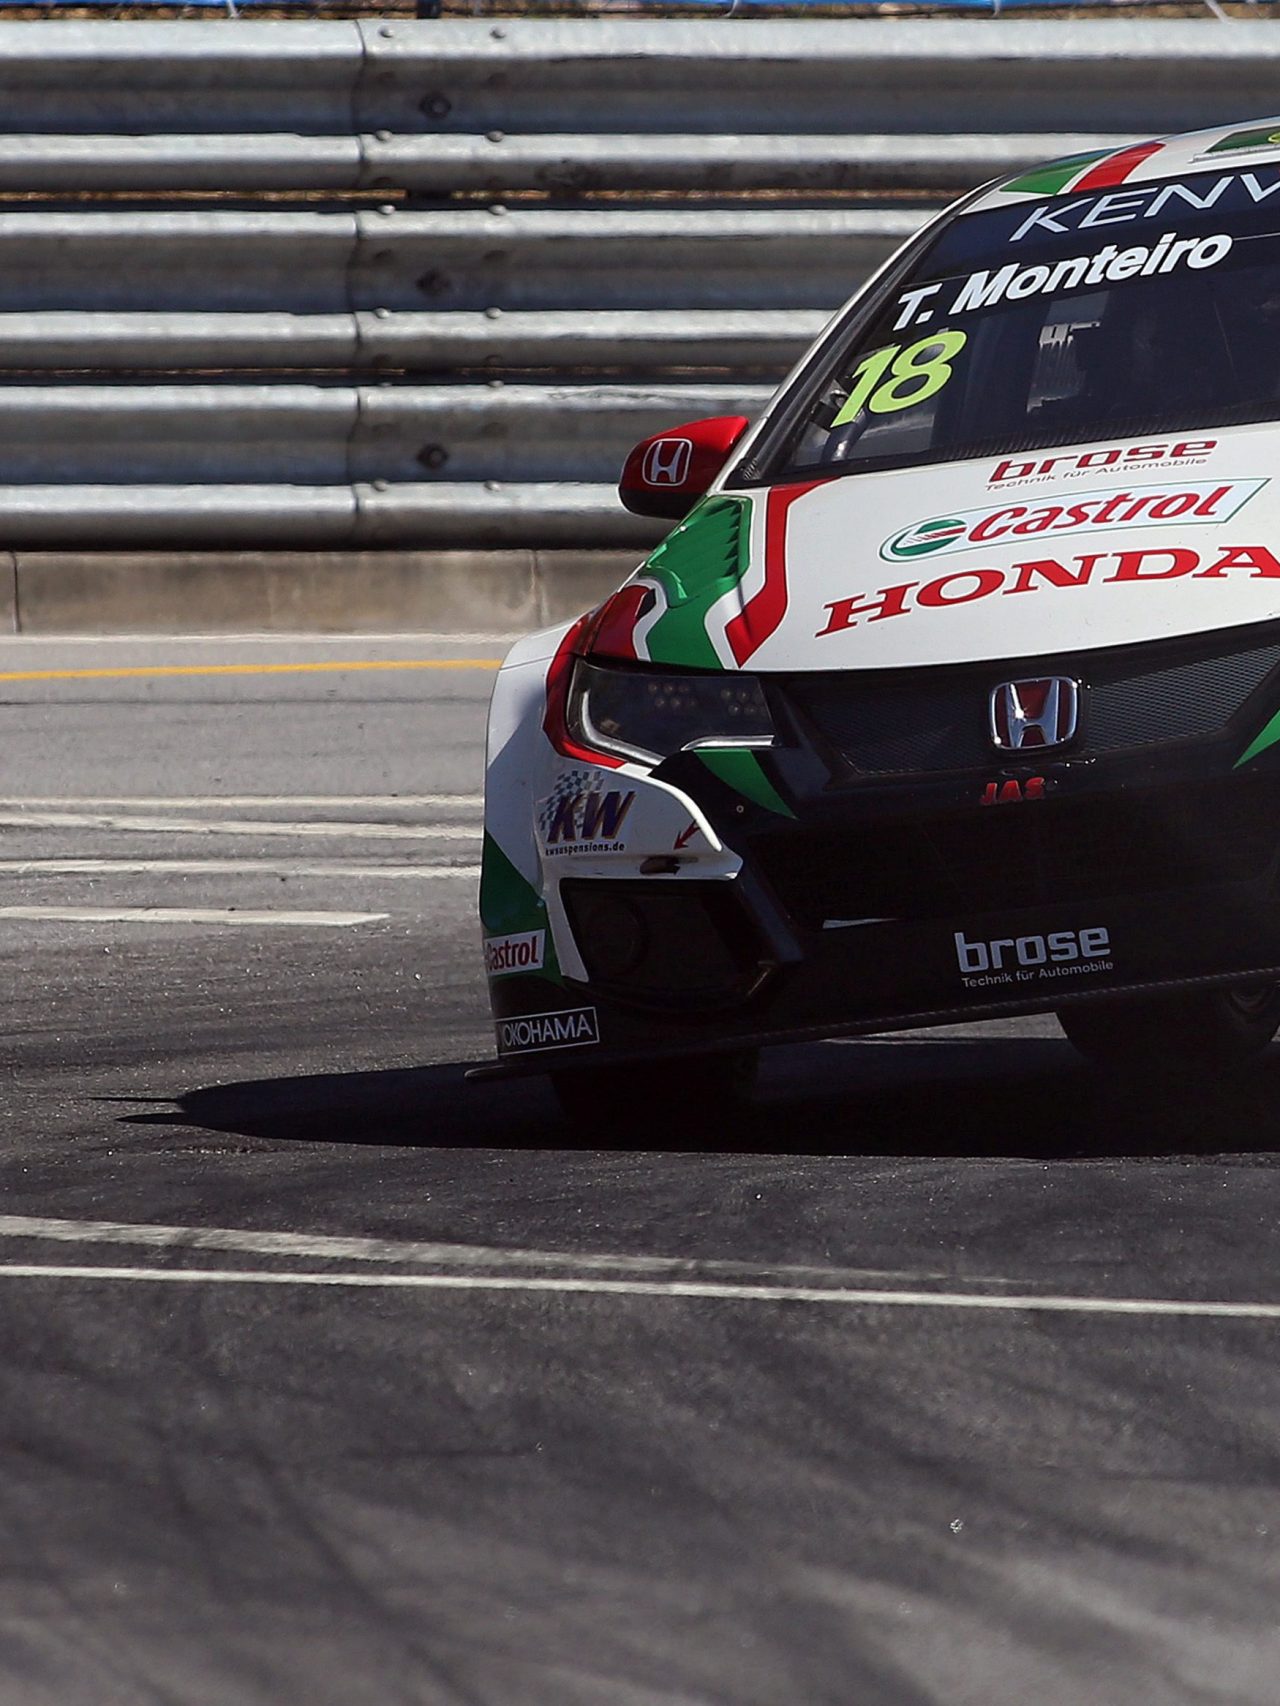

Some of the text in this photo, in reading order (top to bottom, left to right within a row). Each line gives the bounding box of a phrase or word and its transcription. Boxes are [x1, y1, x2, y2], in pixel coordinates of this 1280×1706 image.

[893, 232, 1233, 331] T. Monteiro
[830, 331, 967, 429] 18
[985, 458, 1208, 491] Technik für Automobile
[989, 440, 1217, 483] brose
[967, 485, 1234, 542] Castrol
[546, 791, 637, 844] KW
[954, 927, 1111, 973] brose
[961, 960, 1114, 988] Technik für Automobile
[502, 1014, 593, 1047] OKOHAMA
